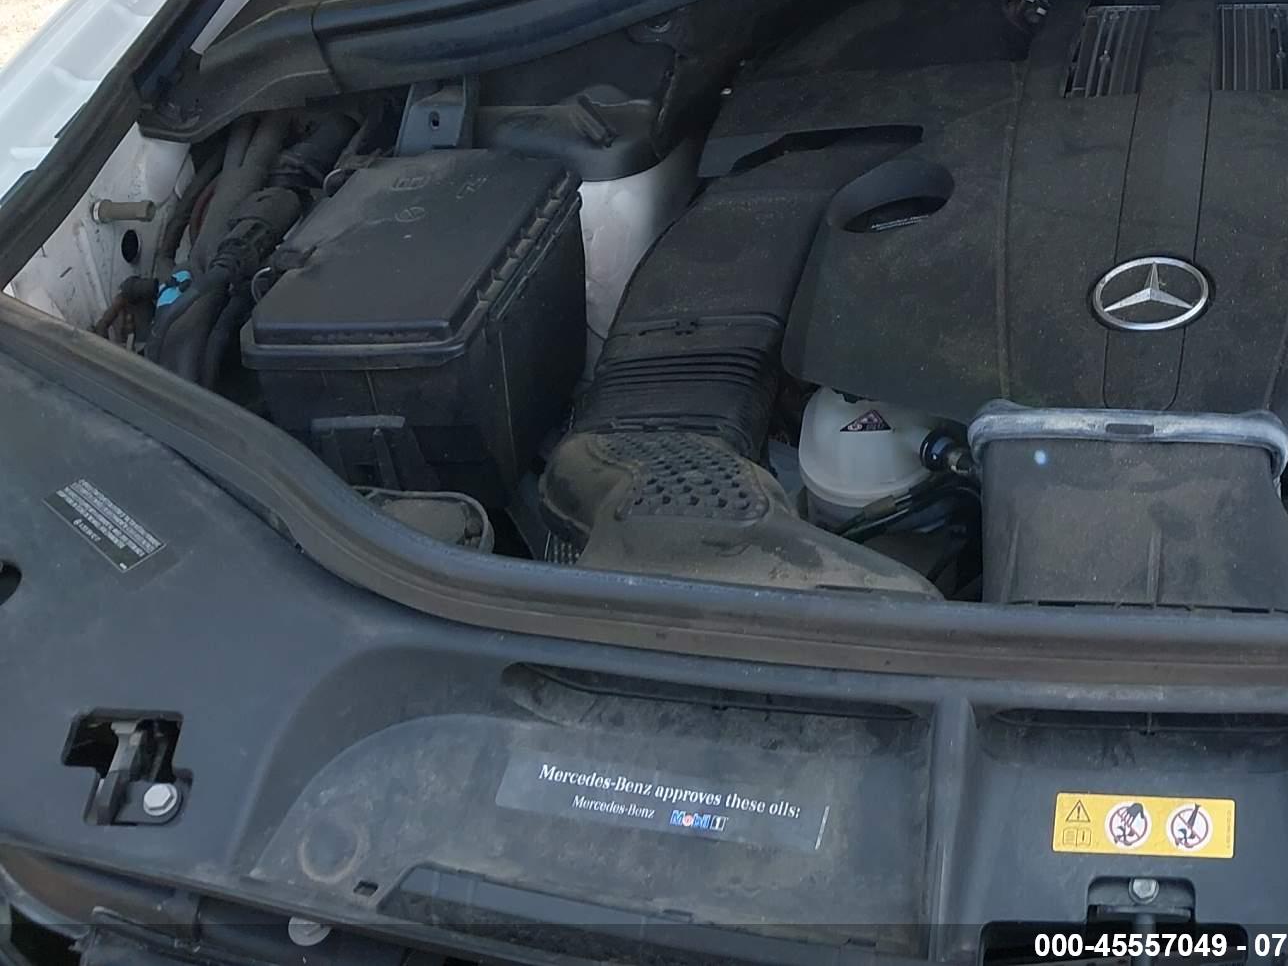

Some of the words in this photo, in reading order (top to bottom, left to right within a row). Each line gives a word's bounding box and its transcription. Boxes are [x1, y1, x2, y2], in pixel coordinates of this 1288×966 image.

[539, 763, 653, 797] Mercedes-Benz
[654, 785, 722, 807] approves
[725, 793, 766, 814] these
[571, 794, 656, 820] Mercedes-Benz
